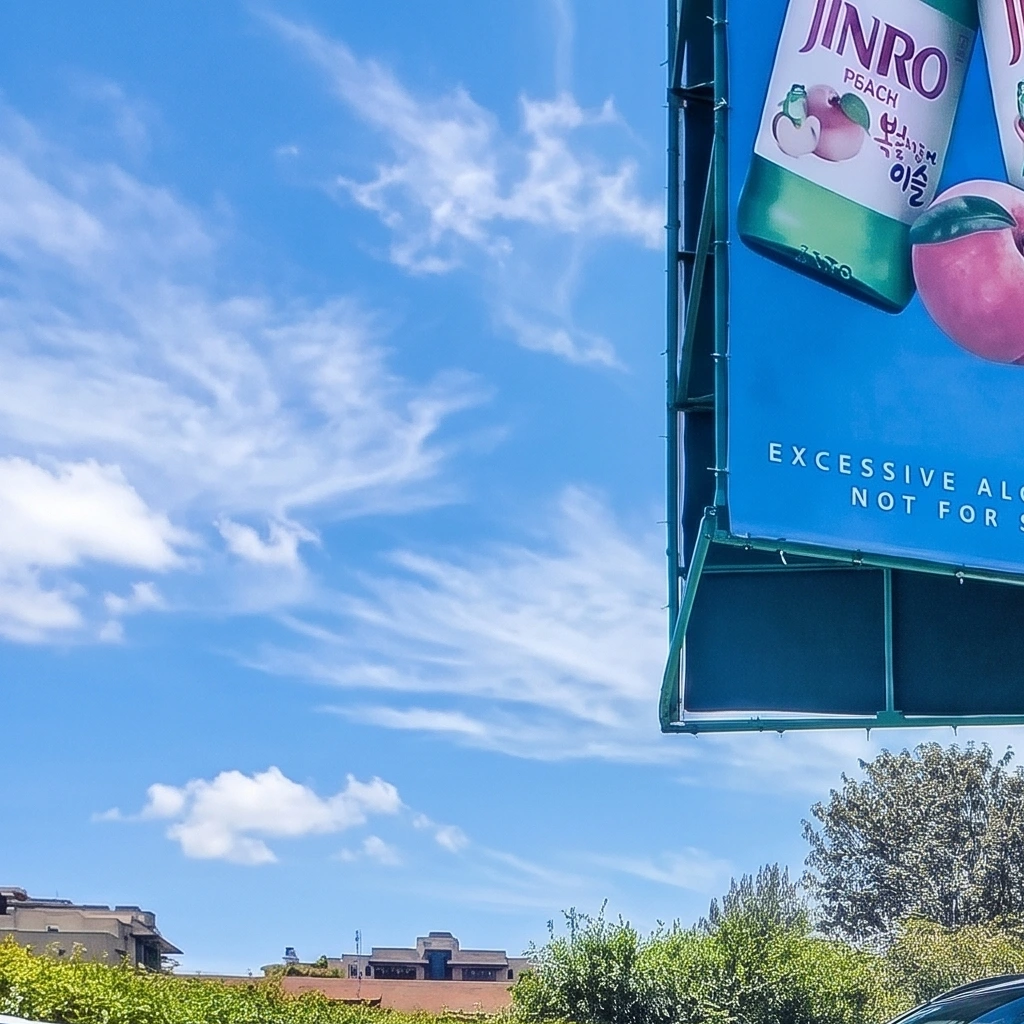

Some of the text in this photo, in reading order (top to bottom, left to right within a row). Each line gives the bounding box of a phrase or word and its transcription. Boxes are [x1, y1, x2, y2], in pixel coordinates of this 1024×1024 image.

[799, 0, 948, 99] JINRO
[768, 443, 956, 491] EXCESSIVE
[851, 487, 915, 515] NOT
[938, 502, 998, 527] FOR
